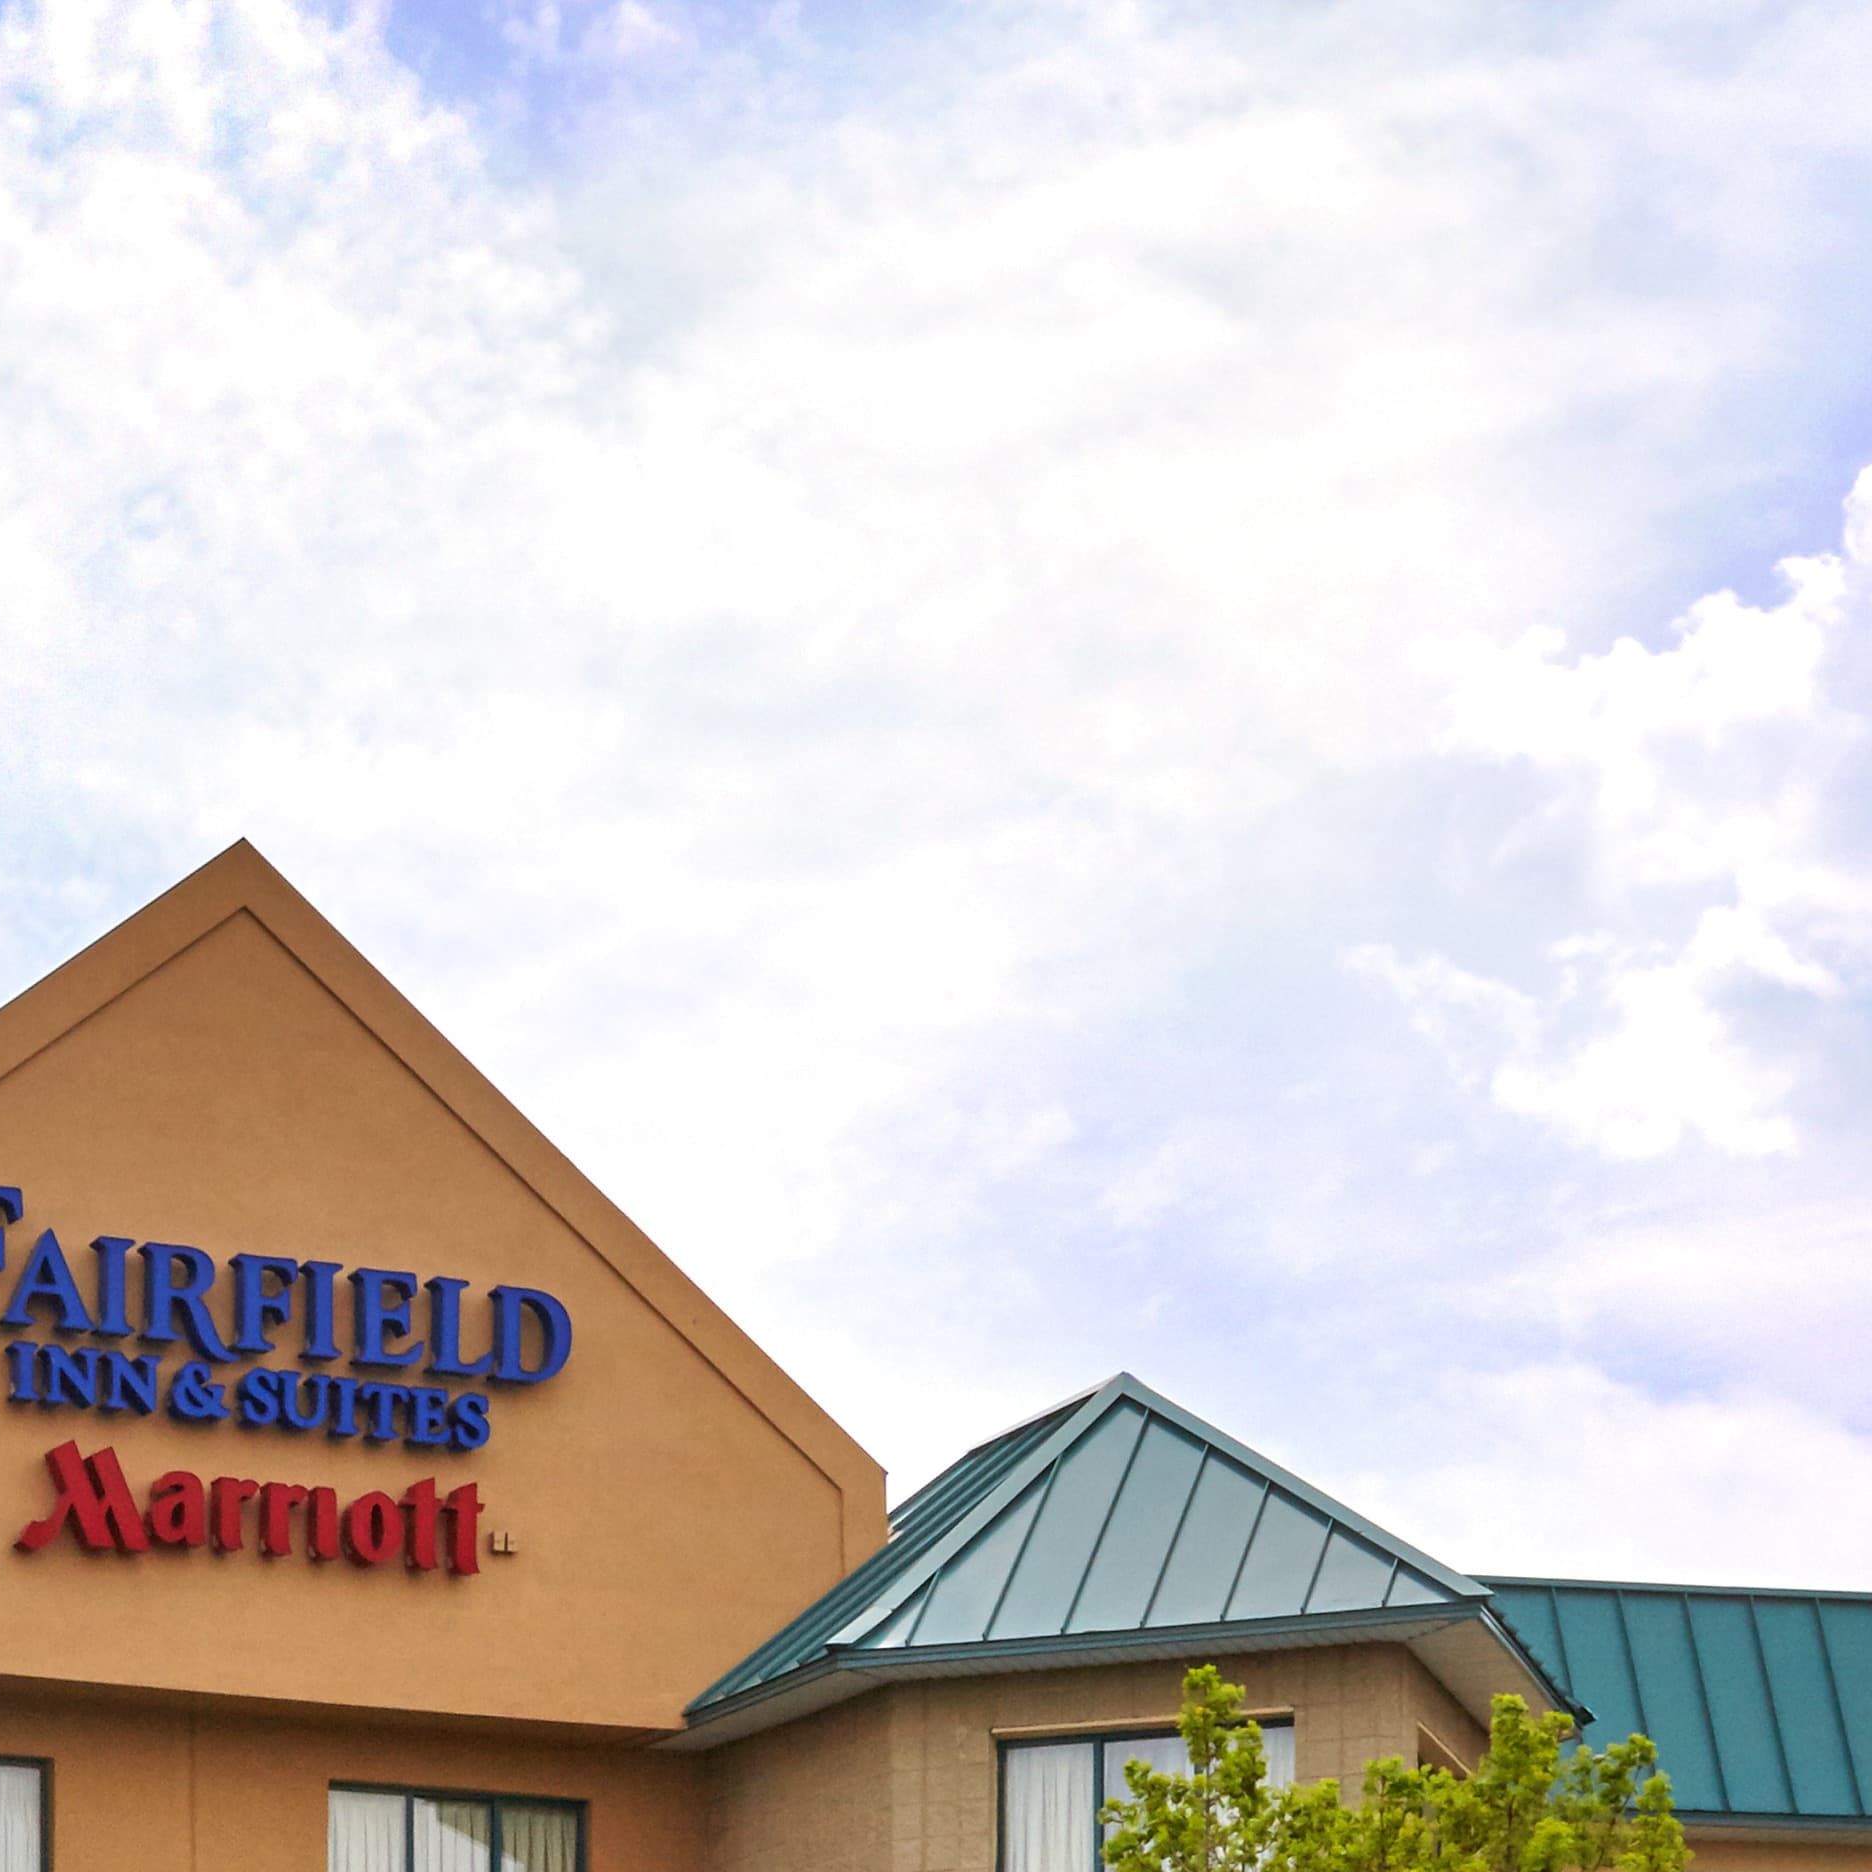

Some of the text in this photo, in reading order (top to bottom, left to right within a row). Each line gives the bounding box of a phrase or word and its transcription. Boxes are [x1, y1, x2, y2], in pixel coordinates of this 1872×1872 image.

[5, 1341, 162, 1416] INN
[238, 1367, 491, 1449] SUITES
[13, 1440, 484, 1574] Marriott
